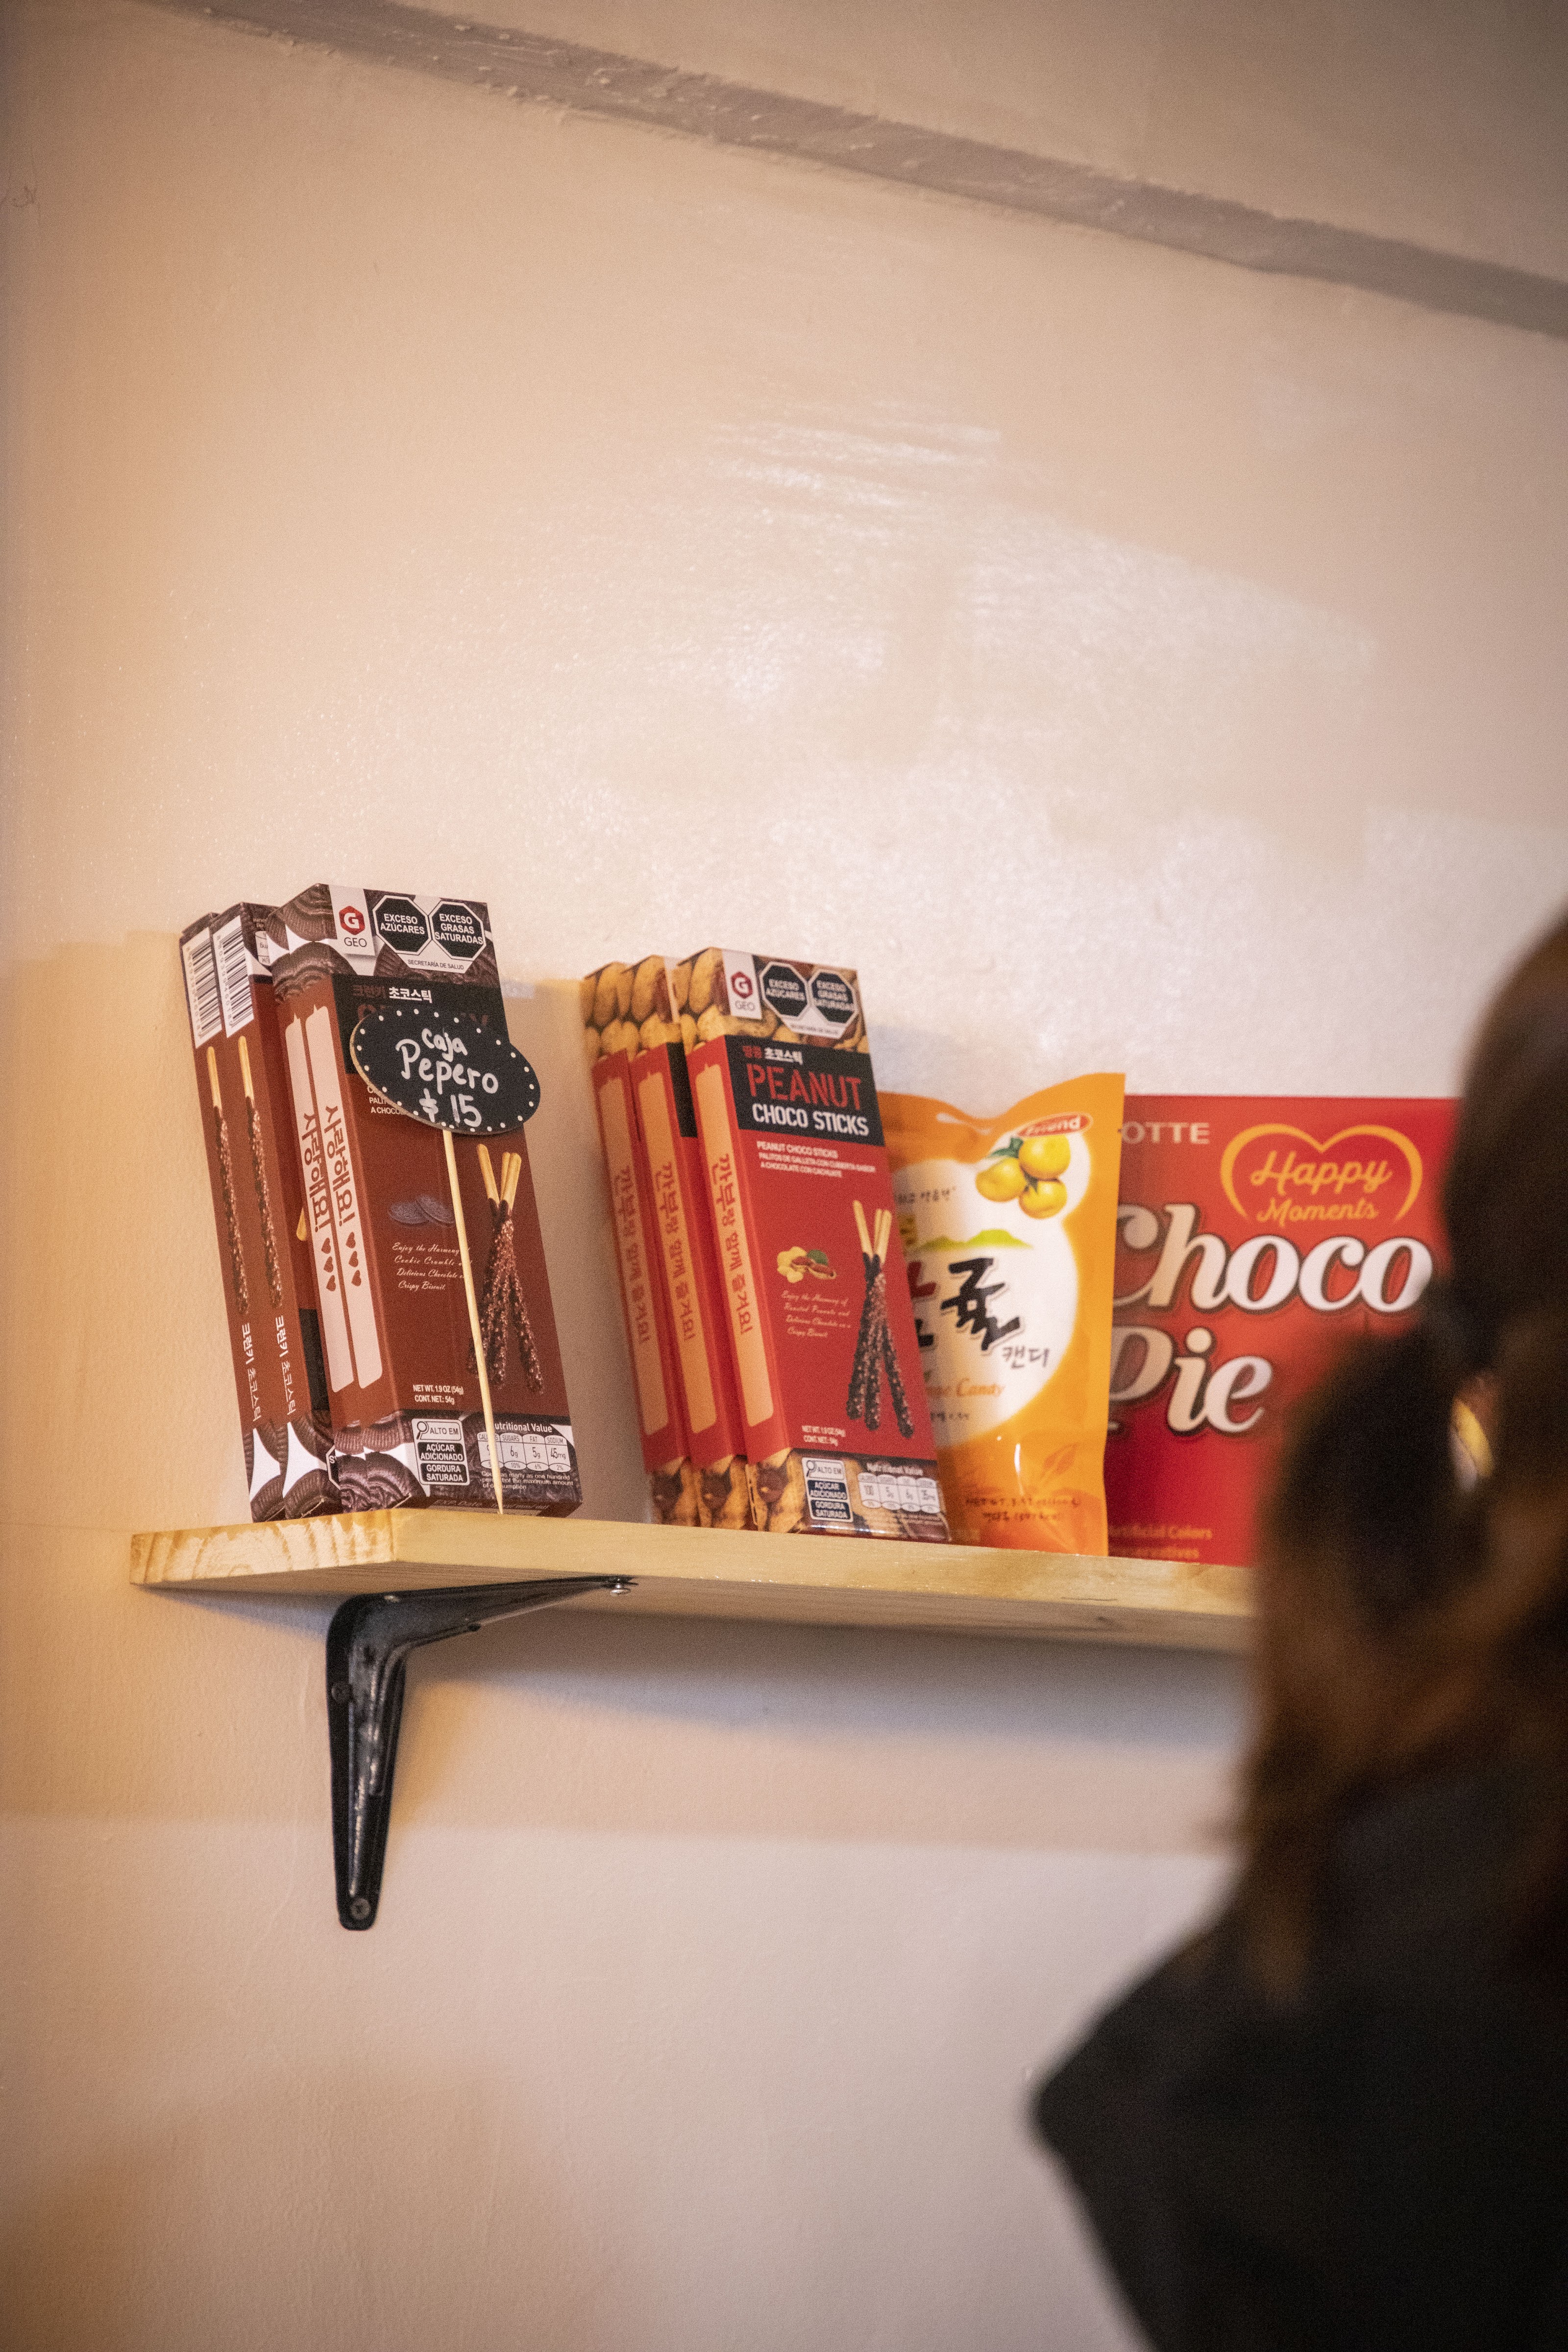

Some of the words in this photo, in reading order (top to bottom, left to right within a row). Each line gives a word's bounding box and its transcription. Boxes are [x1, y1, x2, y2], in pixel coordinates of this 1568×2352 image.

[384, 913, 417, 924] EXCESO
[439, 914, 472, 925] EXCESO
[380, 922, 425, 935] AZÚCARES
[441, 923, 474, 934] GRASAS
[344, 937, 367, 947] GEO
[435, 932, 484, 945] SATURADAS
[389, 986, 433, 1003] 초코스틱
[735, 1001, 755, 1011] GEO
[395, 1039, 498, 1094] Pepero
[746, 1063, 861, 1110] PEANUT
[419, 1088, 439, 1123] $
[451, 1094, 482, 1127] 15
[752, 1103, 808, 1128] CHOCO
[812, 1110, 869, 1136] STICKS
[1120, 1121, 1210, 1144] OTTE
[757, 1140, 785, 1152] PEANUT
[785, 1144, 812, 1156] CHOCO
[813, 1147, 838, 1159] STICKS
[324, 1105, 356, 1227] 사랑해요!
[302, 1113, 332, 1233] 사랑해요!
[1250, 1151, 1393, 1196] Happy
[1257, 1198, 1380, 1226] Moments
[392, 1242, 413, 1254] Enjoy
[428, 1244, 460, 1256] Harmony
[394, 1255, 421, 1264] Cookie
[424, 1256, 455, 1266] Crumble
[396, 1268, 426, 1276] Delicious
[428, 1270, 458, 1278] Chocolate
[398, 1280, 419, 1292] Crispy
[242, 1323, 254, 1365] 크런키
[1002, 1345, 1050, 1370] 캔디
[275, 1315, 289, 1357] 크런키
[282, 1361, 296, 1415] 초코스틱
[247, 1368, 262, 1421] 초코스틱
[445, 1396, 455, 1405] 54g
[494, 1422, 530, 1431] utritional
[531, 1423, 552, 1432] Value
[426, 1443, 455, 1453] AÇÚCAR
[510, 1446, 518, 1458] 6g
[532, 1446, 540, 1459] 5g
[550, 1447, 566, 1459] 45mg
[420, 1452, 463, 1461] ADICIONADO
[426, 1464, 461, 1473] GORDURA
[426, 1473, 464, 1482] SATURADA
